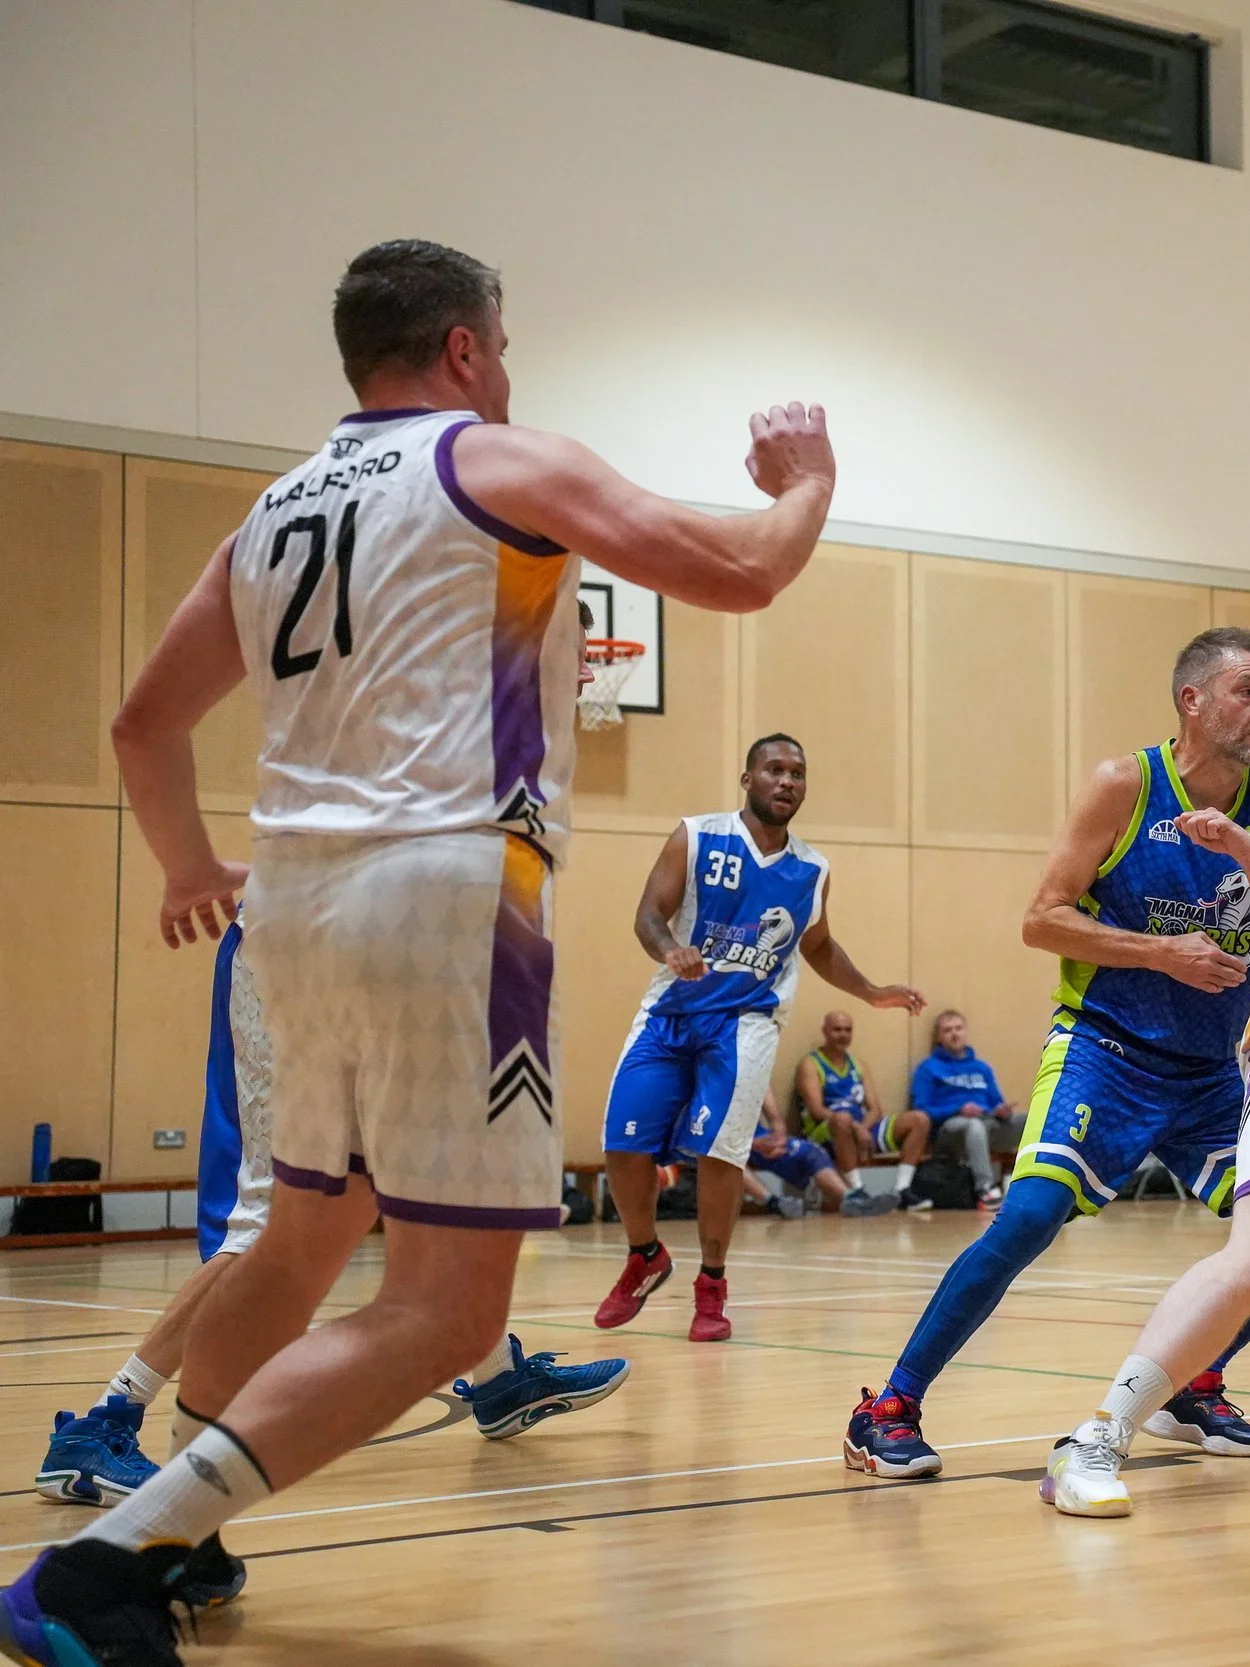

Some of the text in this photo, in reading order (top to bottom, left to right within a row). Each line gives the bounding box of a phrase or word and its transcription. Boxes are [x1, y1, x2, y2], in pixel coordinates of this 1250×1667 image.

[269, 500, 360, 680] 21
[704, 849, 742, 890] 33
[1145, 897, 1206, 923] MAGNA
[1069, 1103, 1092, 1142] 3
